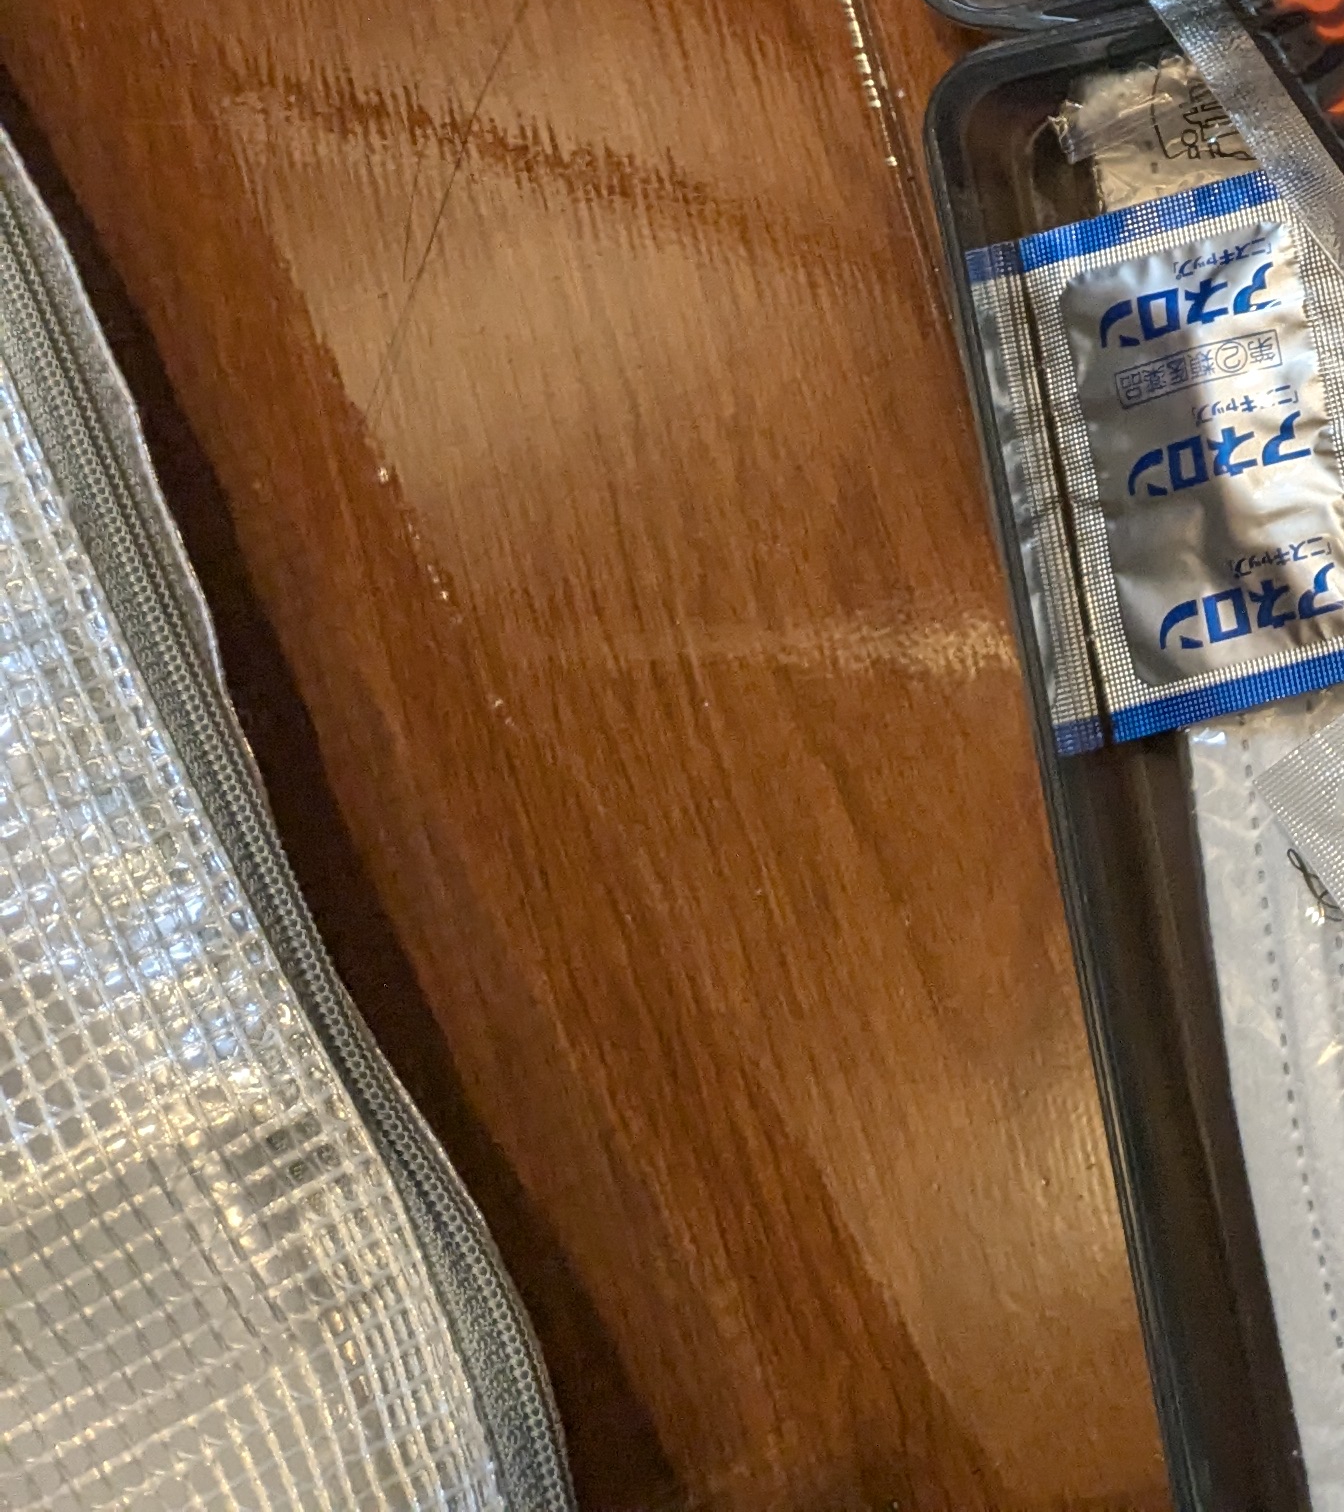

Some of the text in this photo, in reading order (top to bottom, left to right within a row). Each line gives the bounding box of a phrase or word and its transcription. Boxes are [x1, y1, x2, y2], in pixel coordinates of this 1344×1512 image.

[1100, 262, 1279, 349] アネロン
[1128, 410, 1314, 497] アネロン
